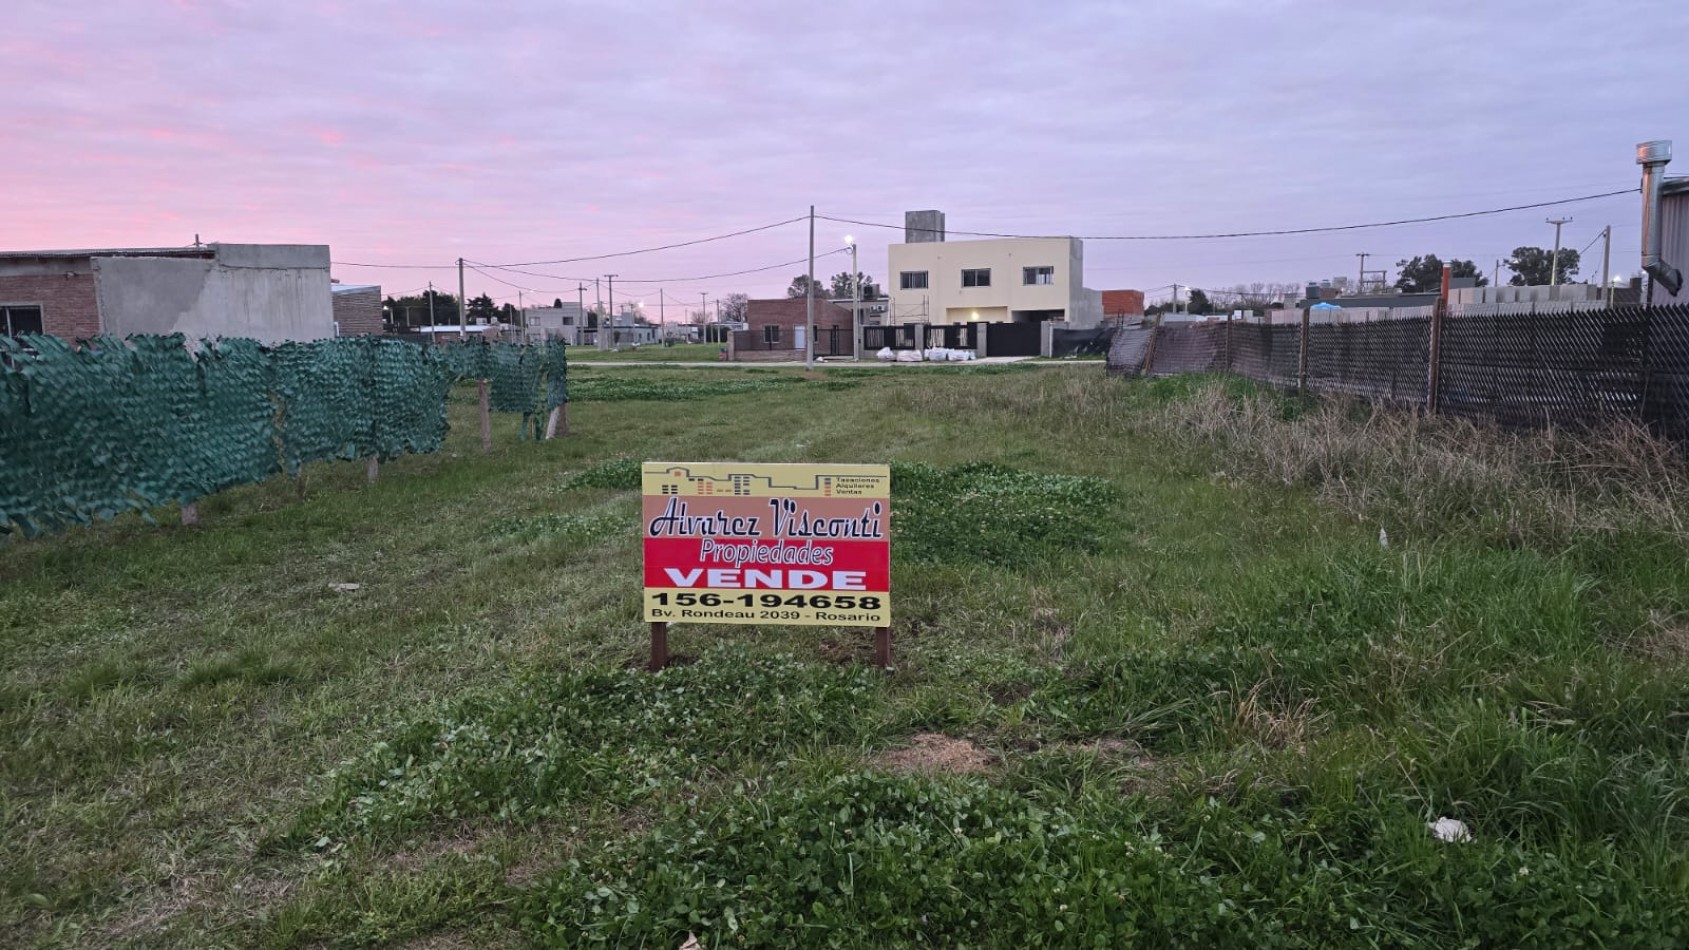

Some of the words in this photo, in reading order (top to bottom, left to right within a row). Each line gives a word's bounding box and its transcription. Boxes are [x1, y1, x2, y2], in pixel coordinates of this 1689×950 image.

[649, 496, 761, 537] Alvarez
[769, 498, 883, 538] Visconti
[700, 538, 833, 567] Propiedades
[663, 568, 867, 590] VENDE
[652, 592, 881, 610] 156-194658
[652, 609, 676, 618] Bv.
[682, 609, 755, 619] Rondeau
[760, 610, 800, 620] 2039
[816, 611, 881, 622] Rosario
